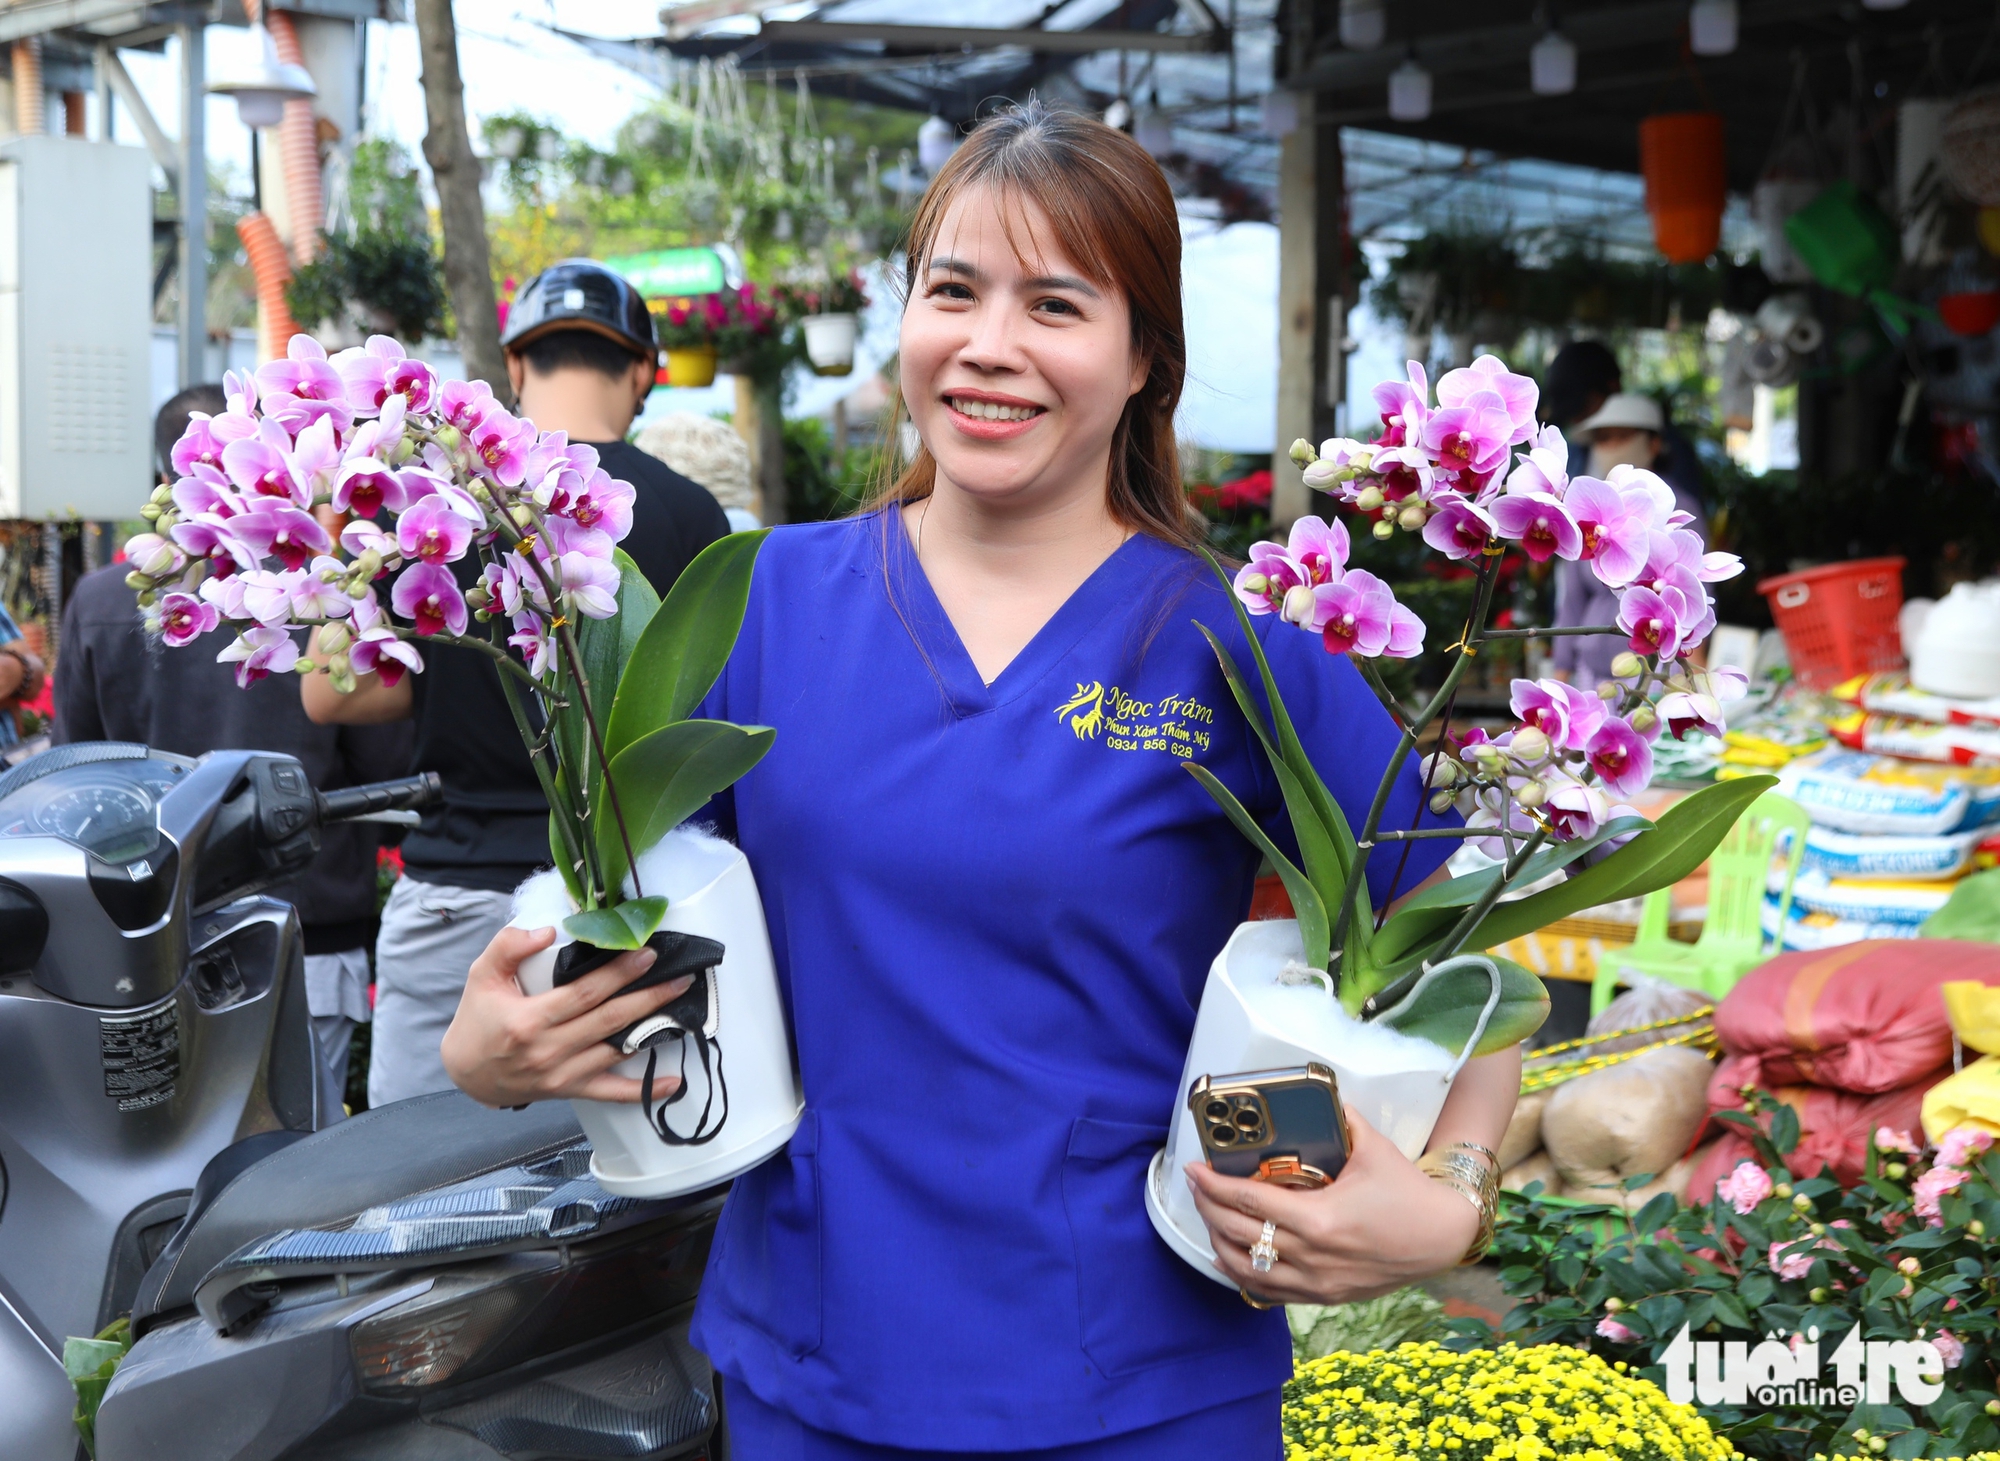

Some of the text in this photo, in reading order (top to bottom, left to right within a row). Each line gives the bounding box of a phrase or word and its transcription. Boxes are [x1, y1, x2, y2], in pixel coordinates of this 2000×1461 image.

[1105, 686, 1213, 724] Ngọc Trâm
[1104, 717, 1210, 751] Phun Xăm Thẩm Mỹ
[1107, 736, 1193, 758] 0934 856 628
